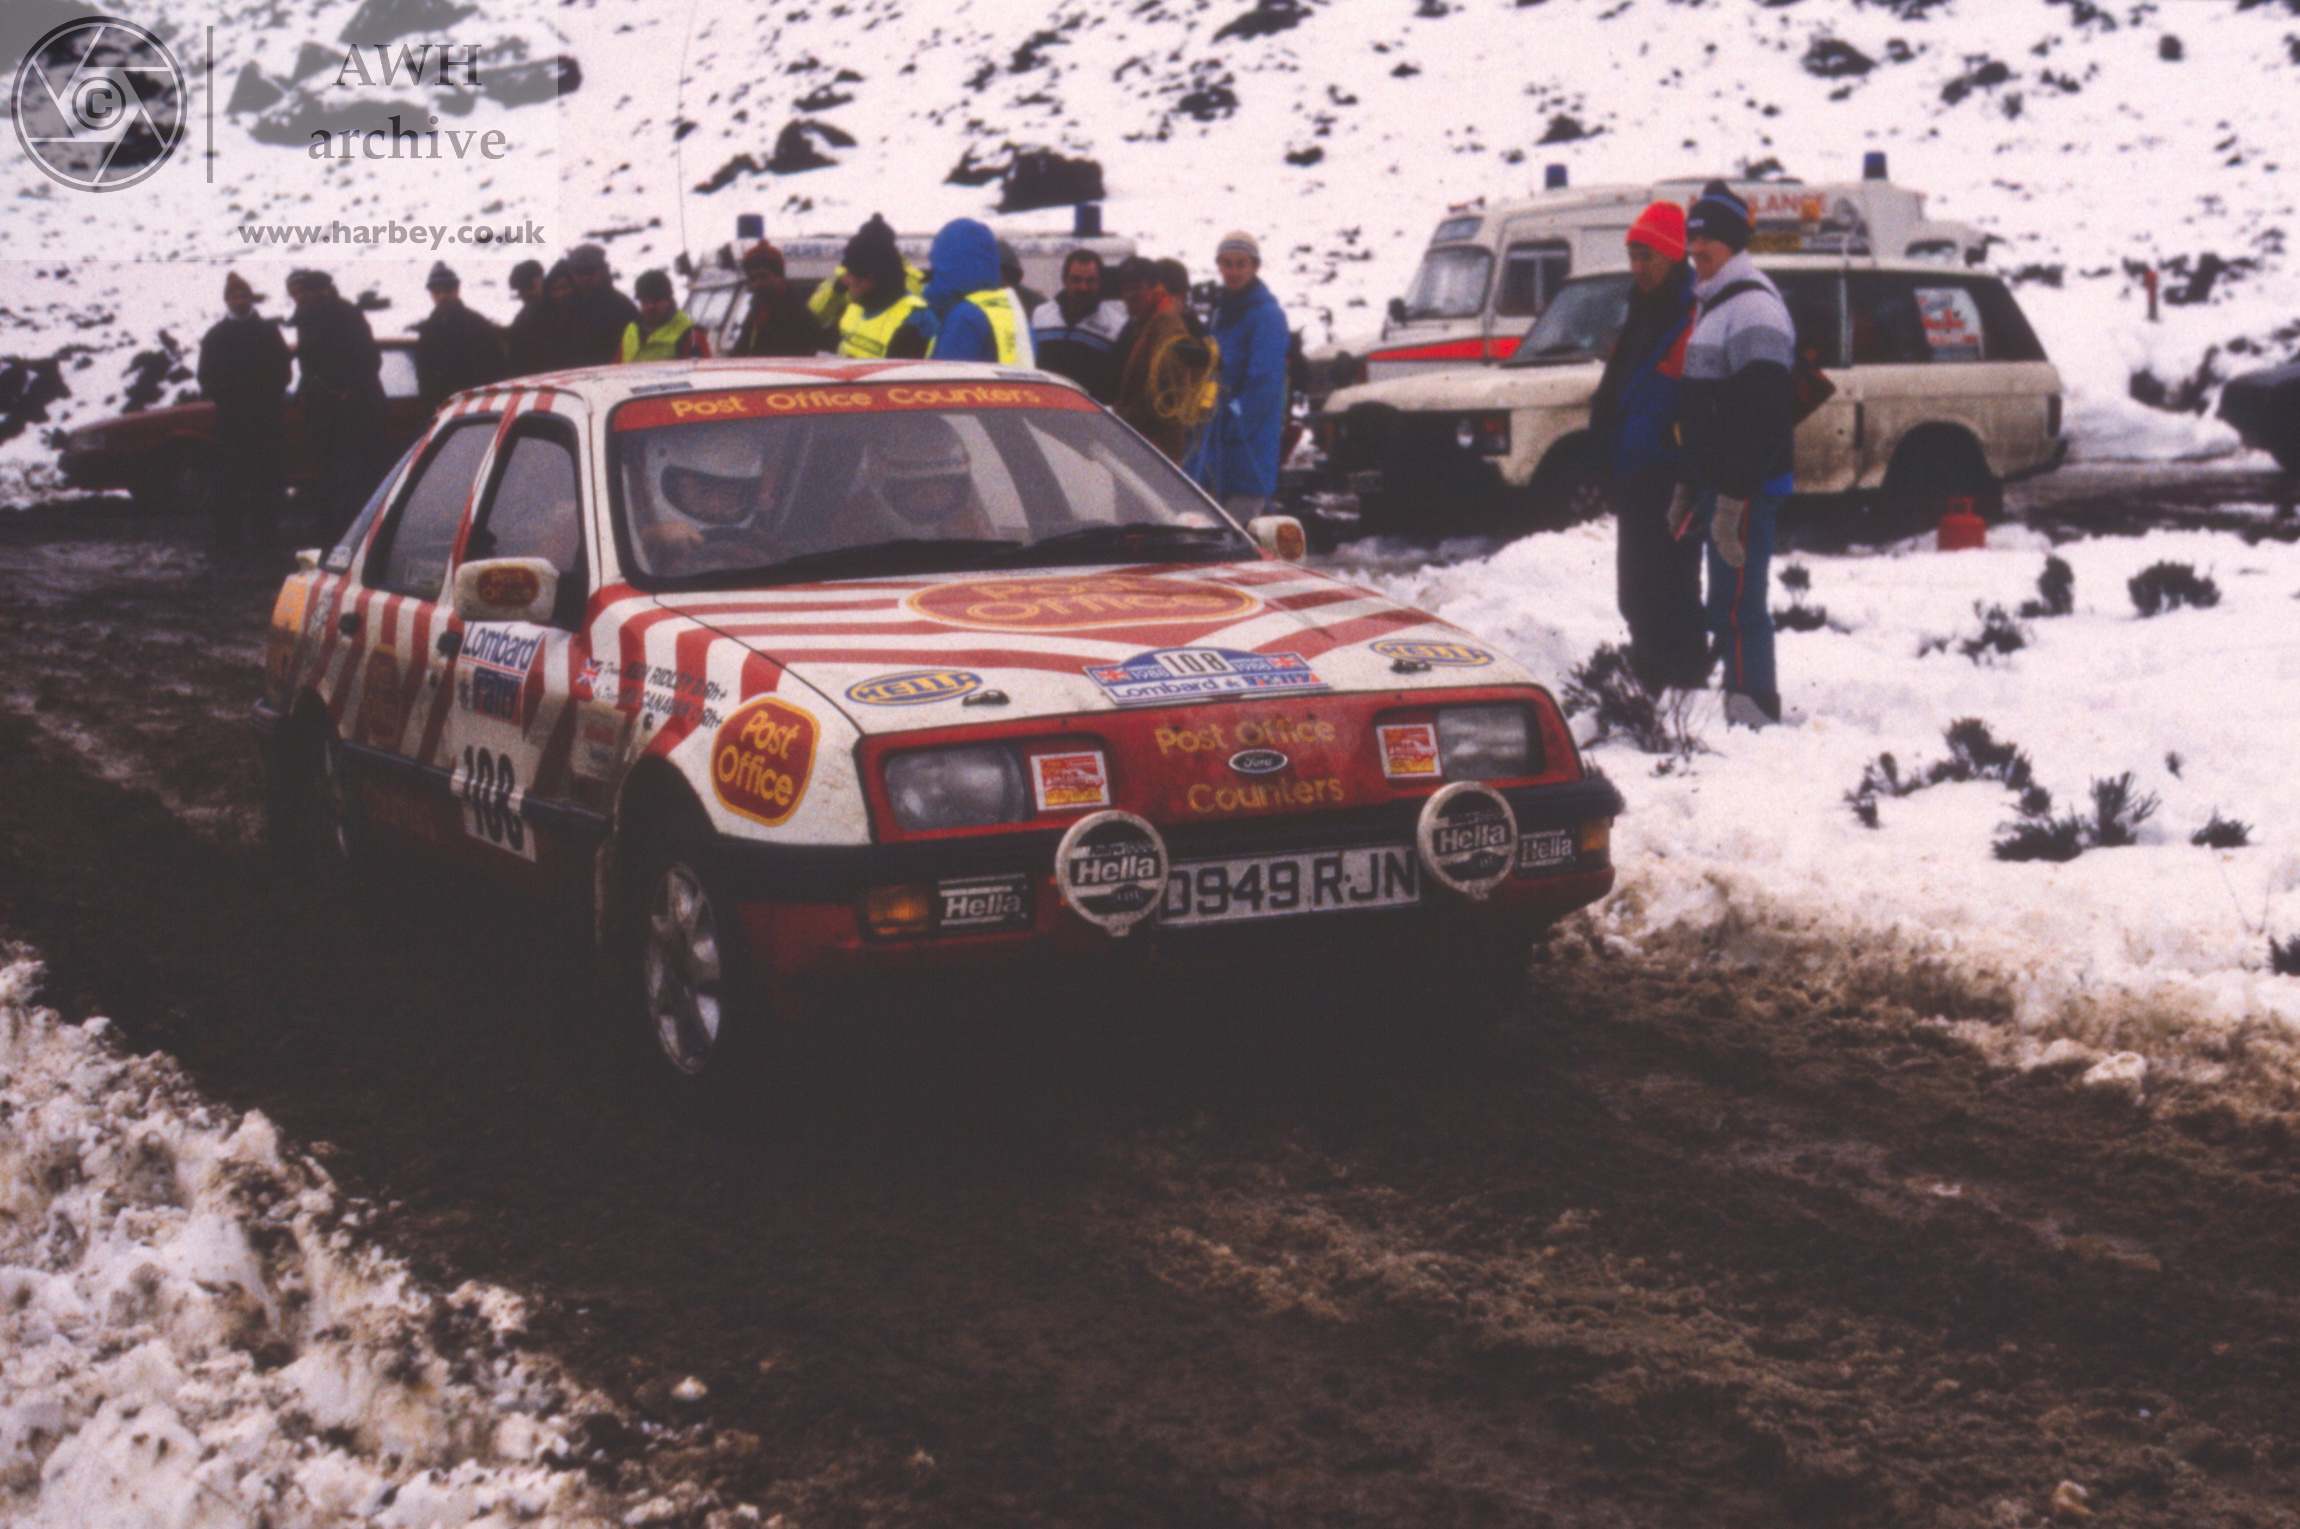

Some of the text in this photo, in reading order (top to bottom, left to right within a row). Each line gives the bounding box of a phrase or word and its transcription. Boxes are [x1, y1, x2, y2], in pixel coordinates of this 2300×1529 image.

[671, 385, 1041, 418] Post Office Counters
[460, 622, 545, 671] Lombard
[1164, 653, 1228, 675] 108
[856, 672, 983, 700] HELLA
[1110, 677, 1220, 698] Lombard
[741, 710, 800, 760] Post
[1155, 717, 1336, 755] Post Office
[718, 745, 793, 806] Office
[1187, 777, 1344, 812] Counters
[1439, 824, 1506, 853] Hella
[1521, 836, 1573, 861] Hella
[1077, 856, 1156, 884] Hella
[1160, 851, 1416, 918] D949 RJN
[945, 892, 1022, 919] Hella
